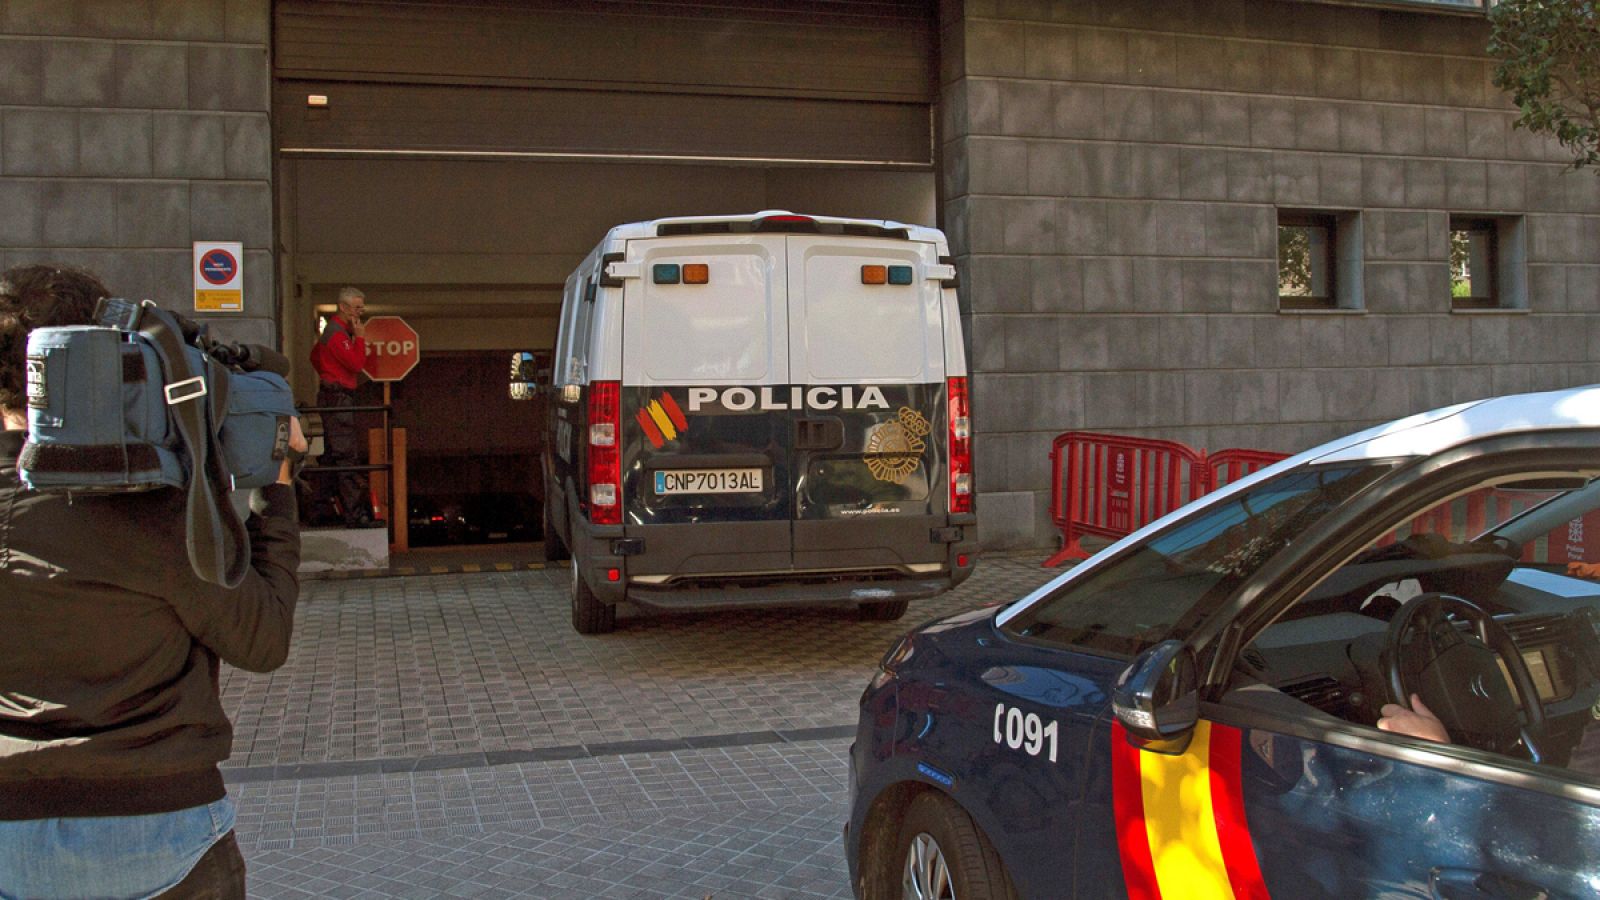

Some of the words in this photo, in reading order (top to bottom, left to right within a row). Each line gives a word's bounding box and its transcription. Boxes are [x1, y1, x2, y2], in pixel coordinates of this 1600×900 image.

[688, 386, 890, 412] POLICIA
[664, 471, 760, 490] CNP7013AL
[1006, 707, 1058, 763] 091
